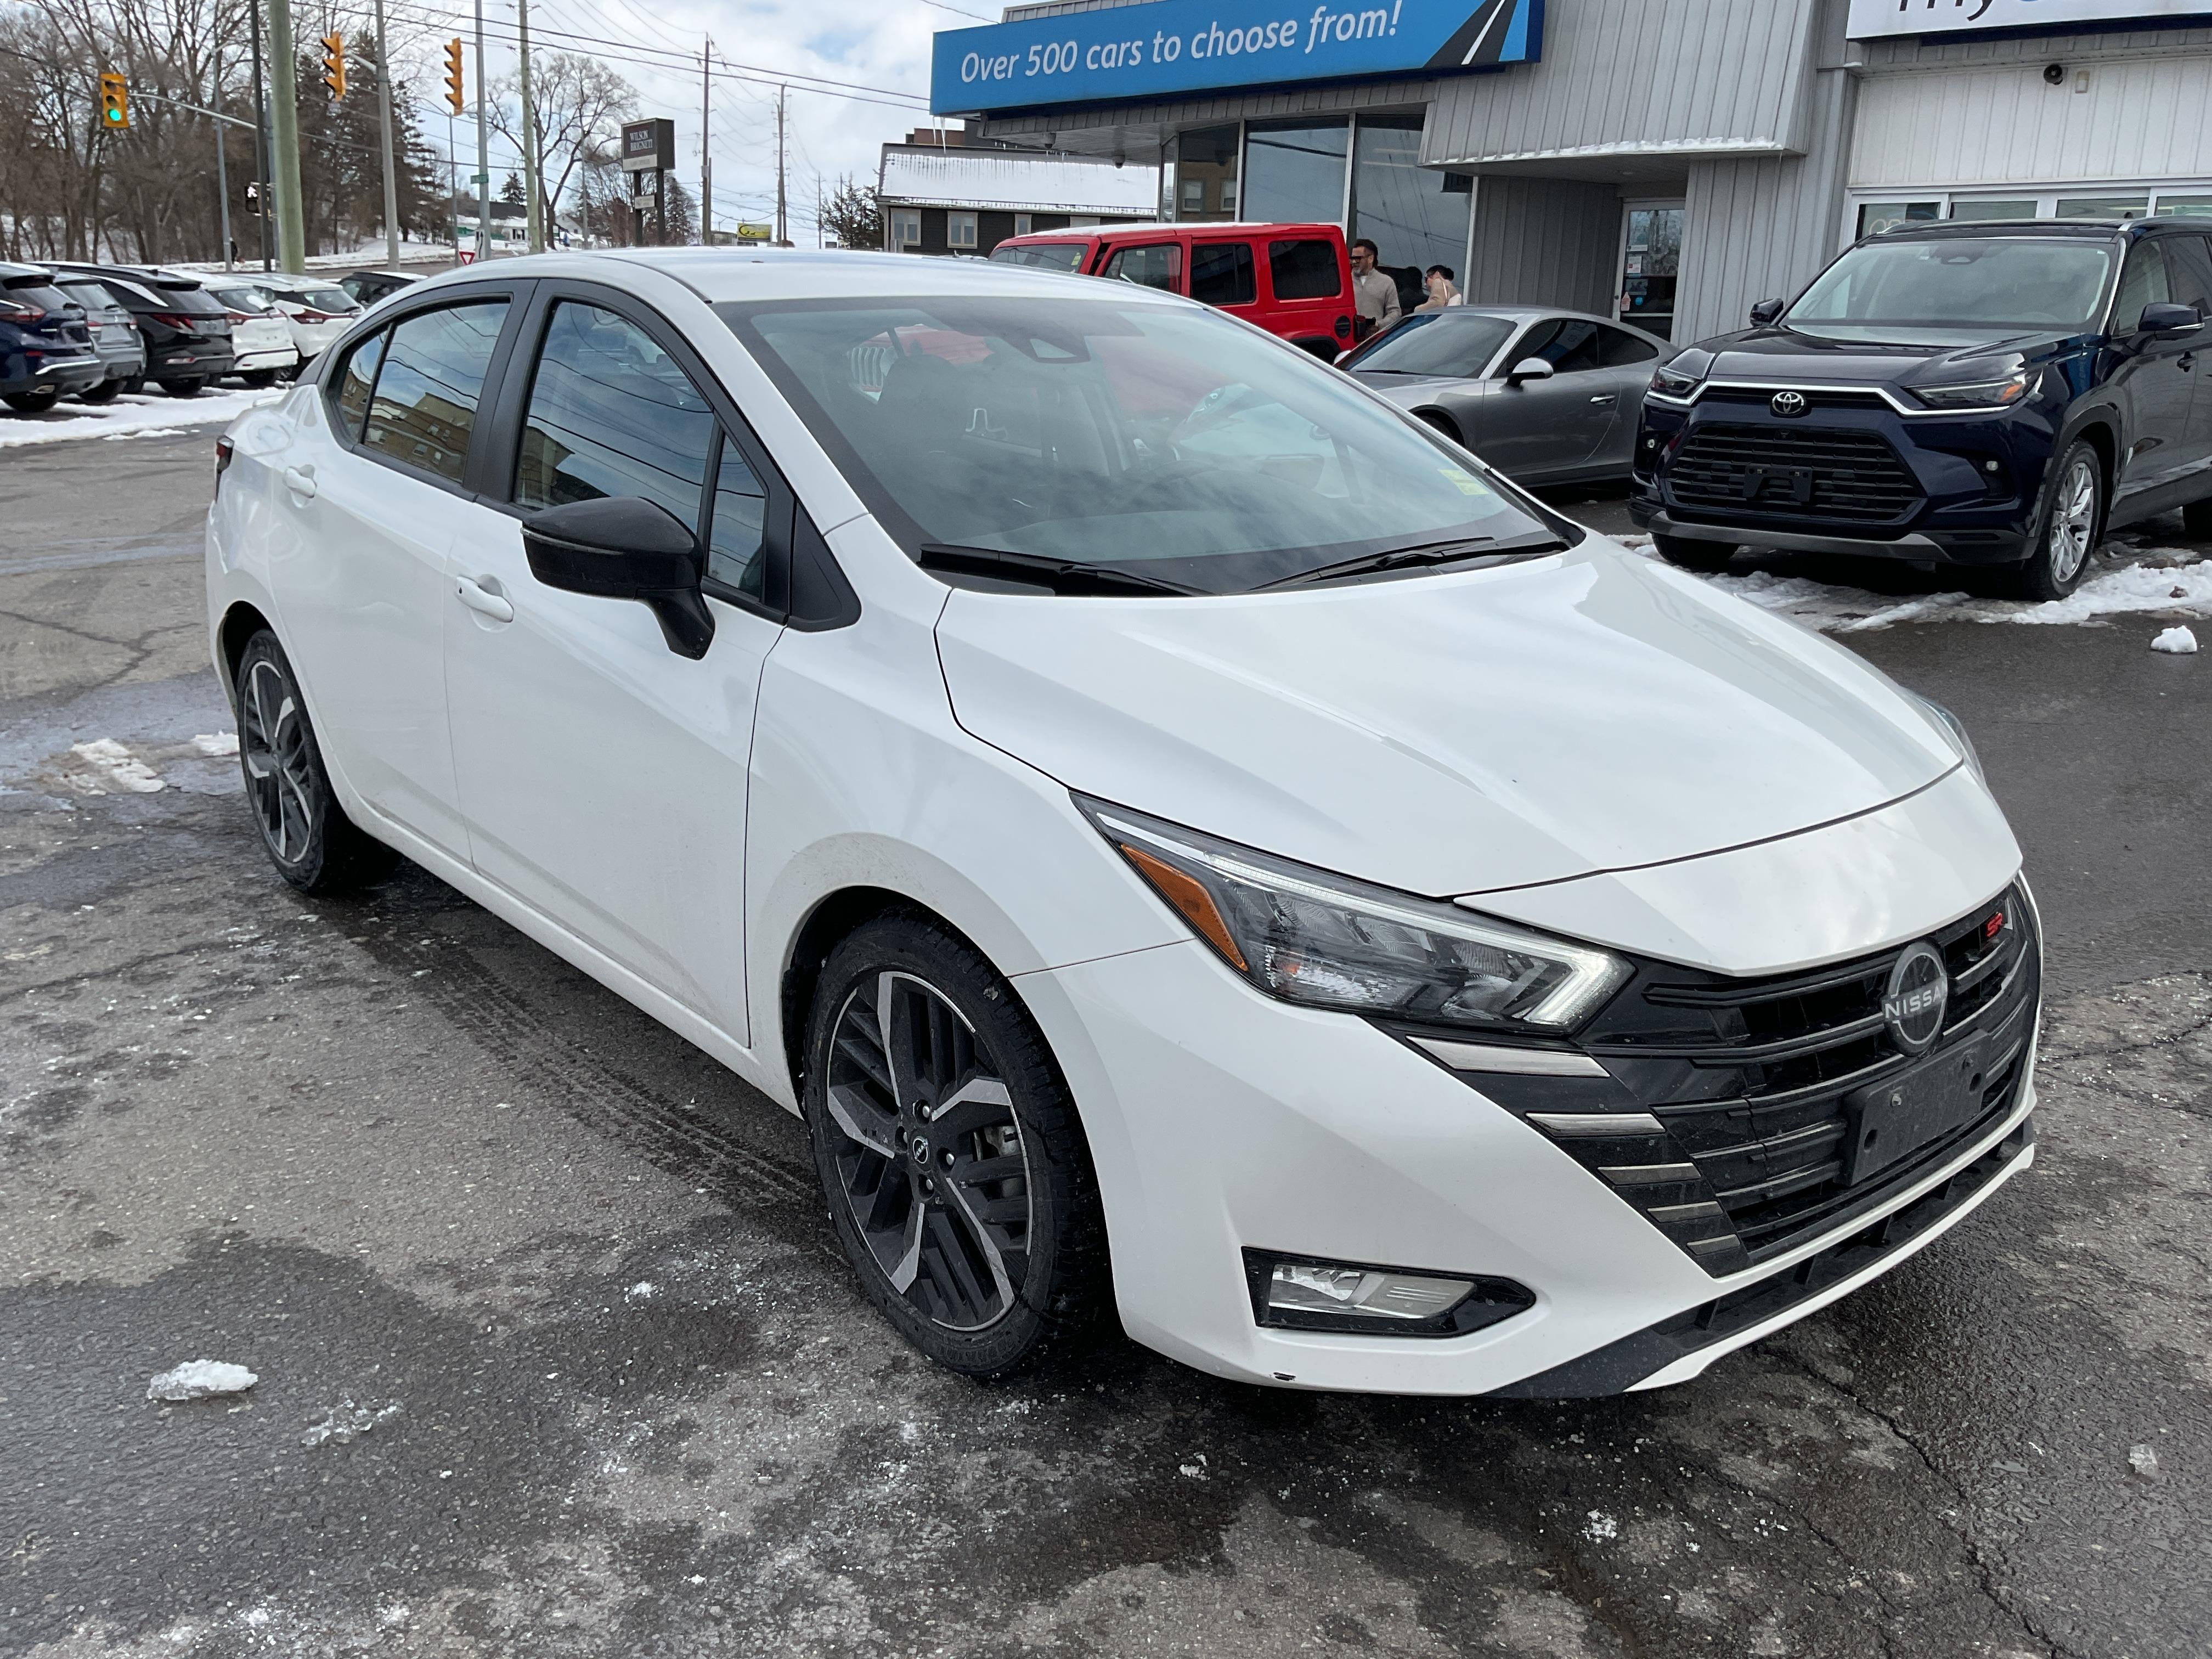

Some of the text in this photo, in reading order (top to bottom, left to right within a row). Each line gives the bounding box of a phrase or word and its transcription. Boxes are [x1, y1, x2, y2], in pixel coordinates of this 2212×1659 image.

[961, 0, 1402, 82] Over 500 cars to choose from!
[630, 130, 648, 140] WILSON
